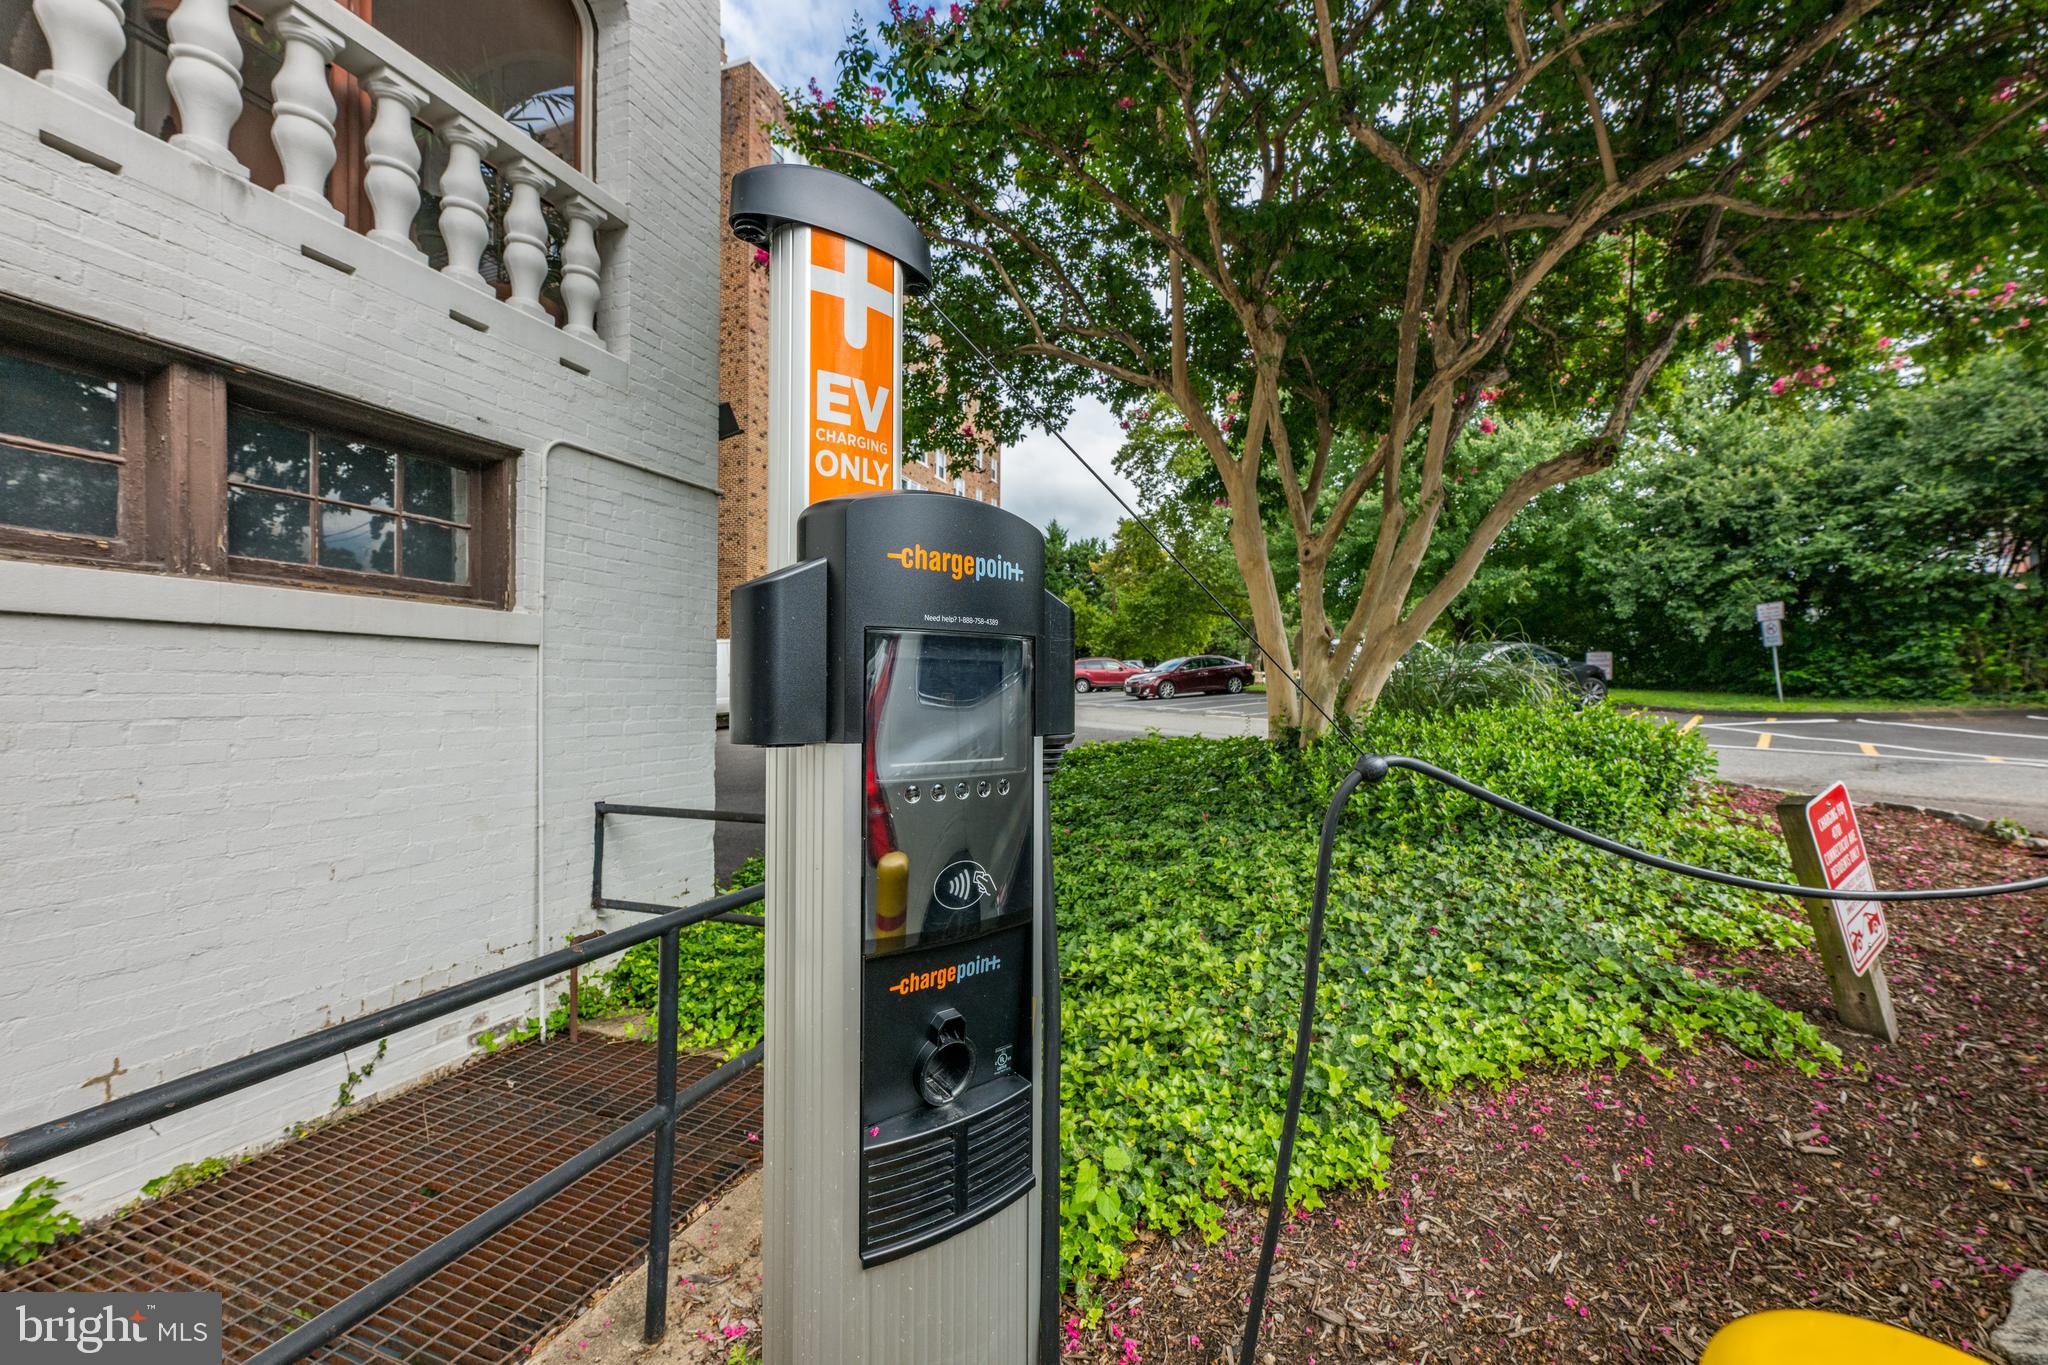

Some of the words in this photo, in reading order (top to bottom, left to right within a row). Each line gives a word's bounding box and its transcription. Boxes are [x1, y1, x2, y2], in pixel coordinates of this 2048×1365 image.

[816, 369, 889, 433] EV
[815, 428, 888, 455] CHARGING
[815, 449, 889, 487] ONLY
[924, 614, 940, 622] Need
[942, 615, 957, 623] help?
